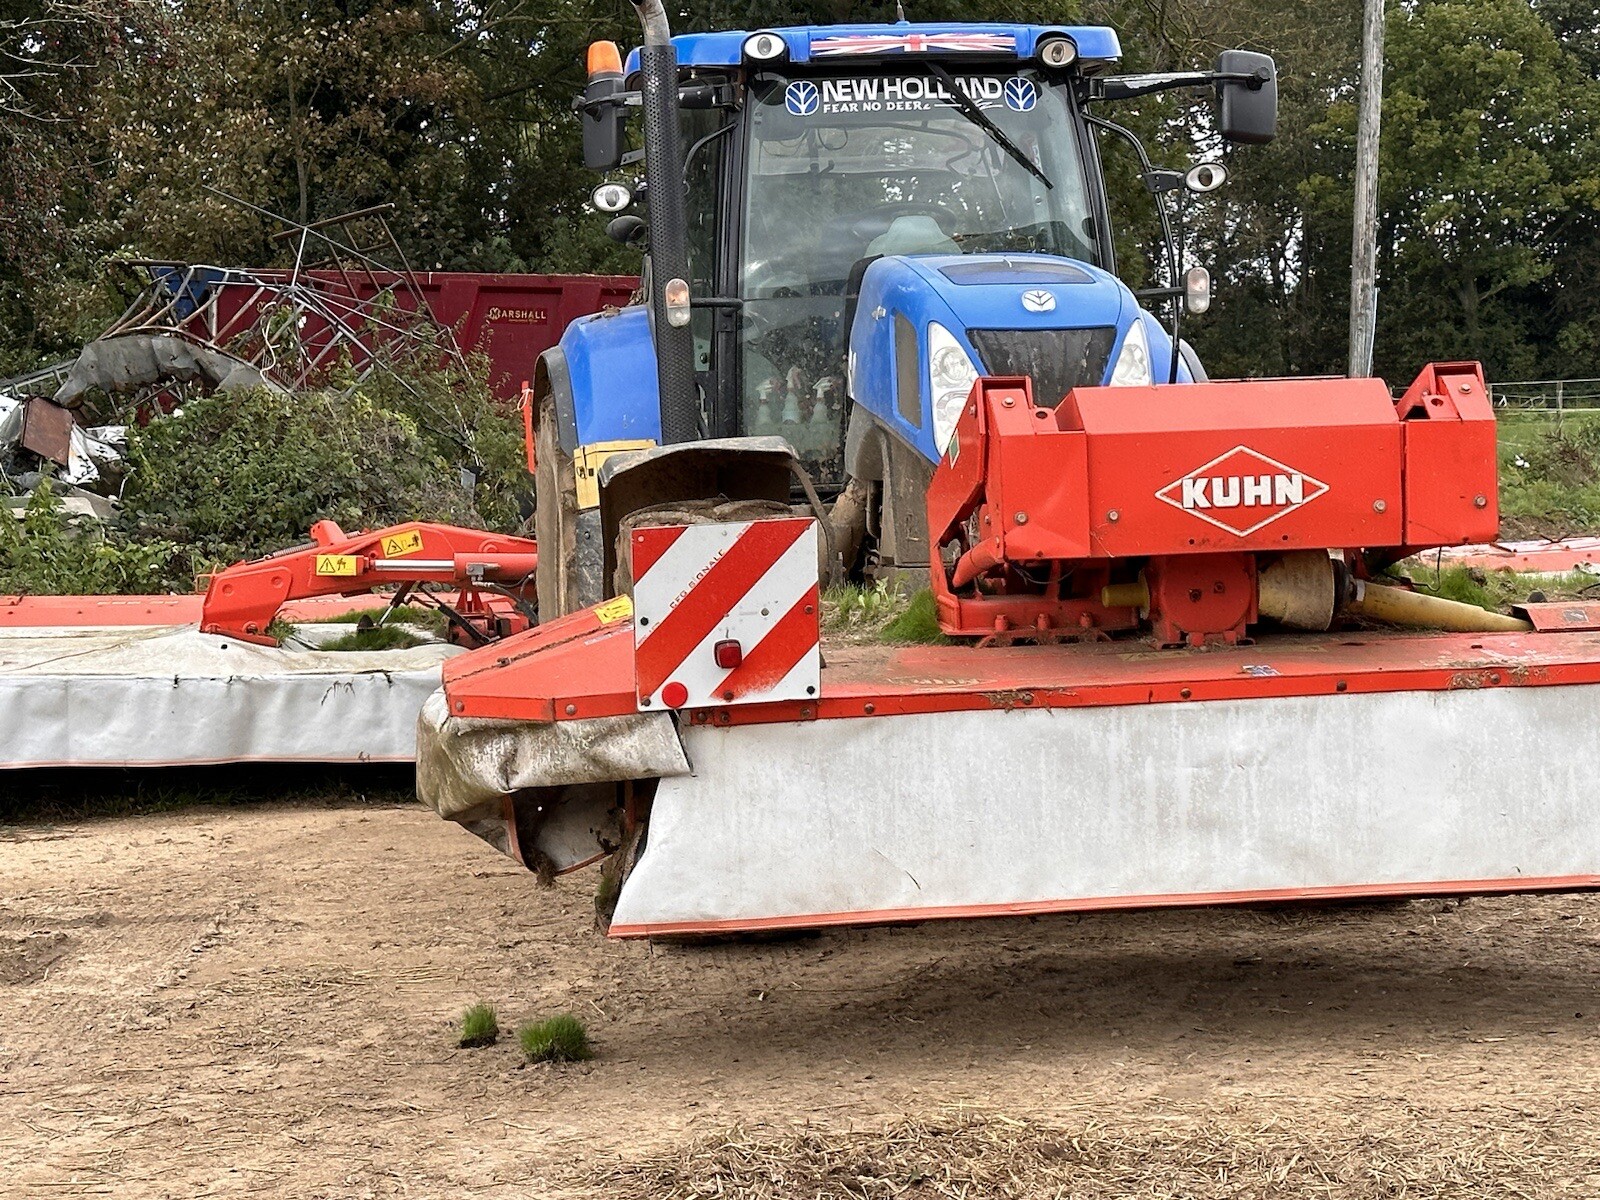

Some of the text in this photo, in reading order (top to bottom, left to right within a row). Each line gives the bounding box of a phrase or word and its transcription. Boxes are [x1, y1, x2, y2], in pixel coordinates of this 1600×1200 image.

[822, 77, 1003, 102] NEW HOLLAND
[823, 102, 859, 114] FEAR
[862, 101, 882, 112] NO
[489, 307, 547, 320] MARSHALL
[1182, 474, 1304, 509] KUHN
